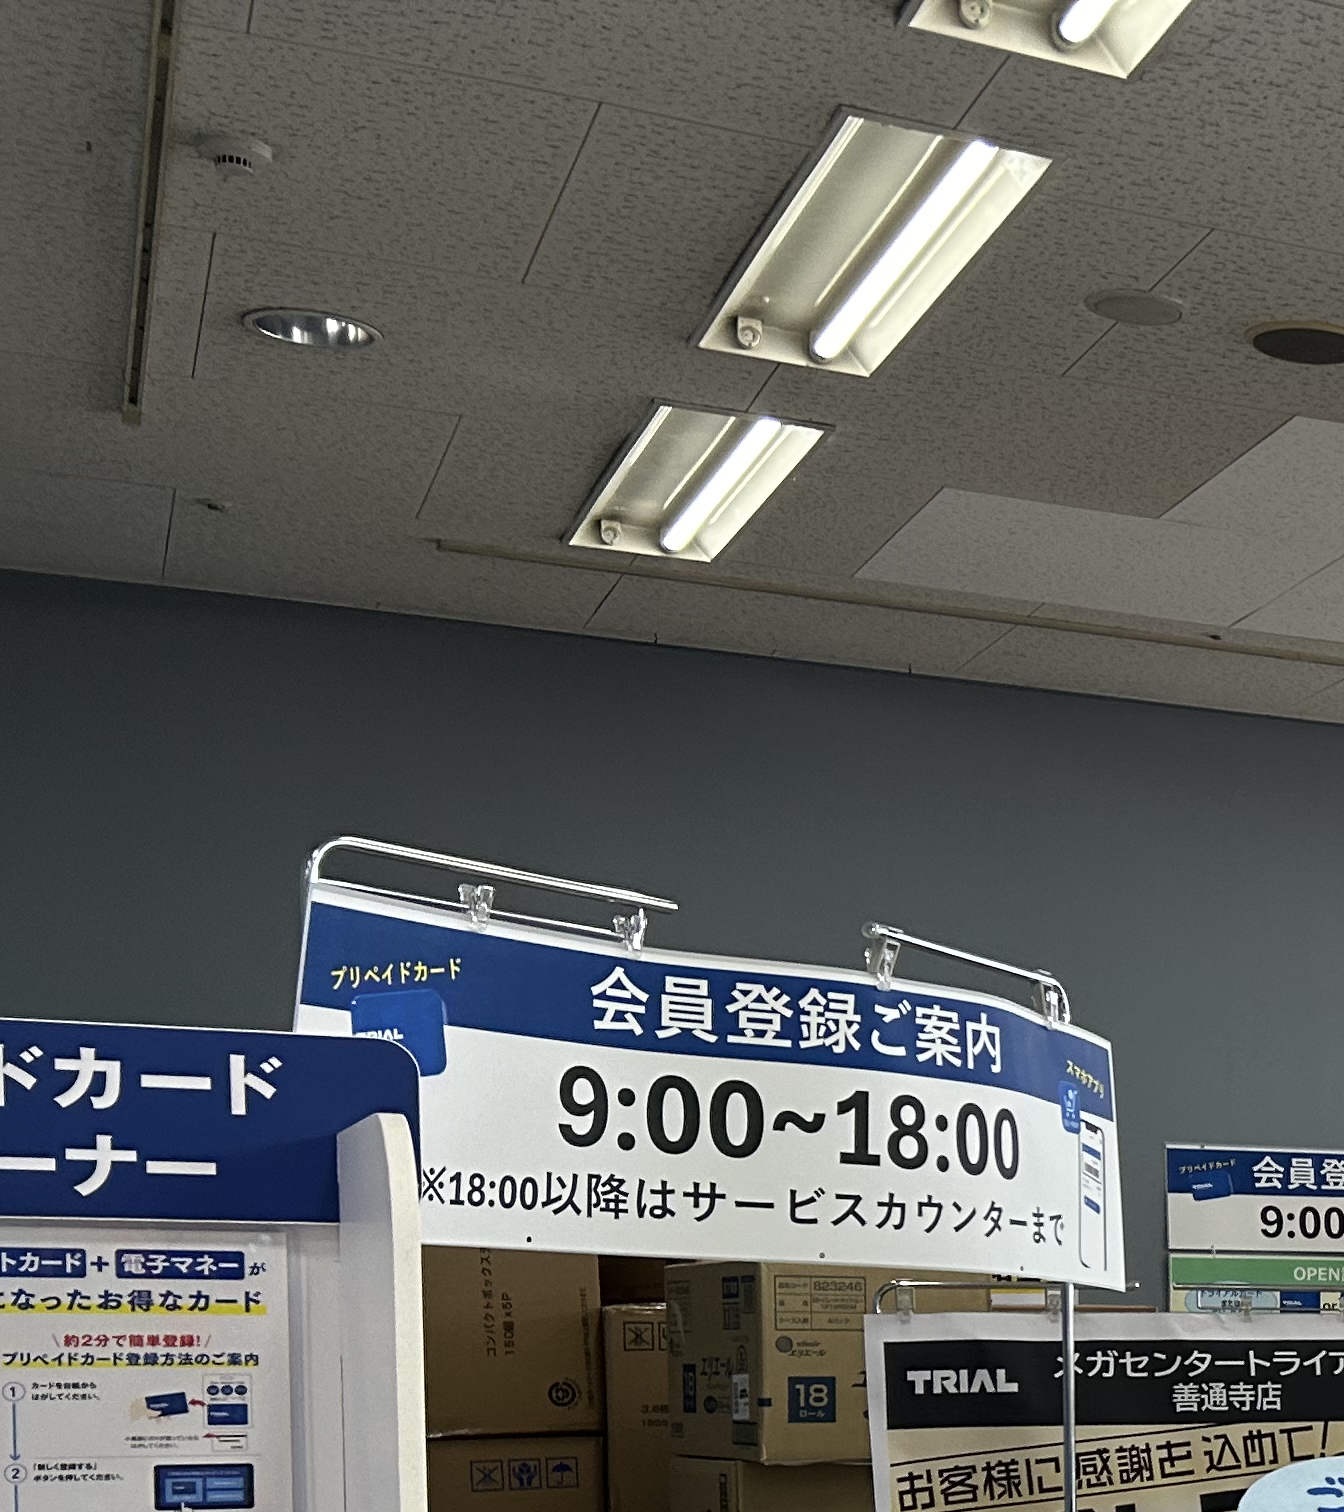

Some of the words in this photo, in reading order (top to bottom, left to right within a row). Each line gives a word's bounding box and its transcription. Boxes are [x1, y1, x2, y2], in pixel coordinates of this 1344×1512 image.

[330, 956, 464, 990] プリペイドカード
[589, 964, 1004, 1076] 会員登録ご案内
[418, 1163, 1067, 1248] ※18:00以降はサービスカウンターまで
[122, 1253, 239, 1275] 電子マネー
[248, 1262, 266, 1276] が
[0, 1289, 262, 1312] なったお得なカード
[63, 1334, 201, 1348] 約2分で簡単登録!
[1, 1352, 259, 1367] プリペイドカード登録方法のご案内
[907, 1369, 1019, 1394] TRIAL
[795, 1384, 828, 1408] 18
[1171, 1382, 1284, 1413] 善通寺店
[897, 1420, 1330, 1512] お客様に感謝を込めて!
